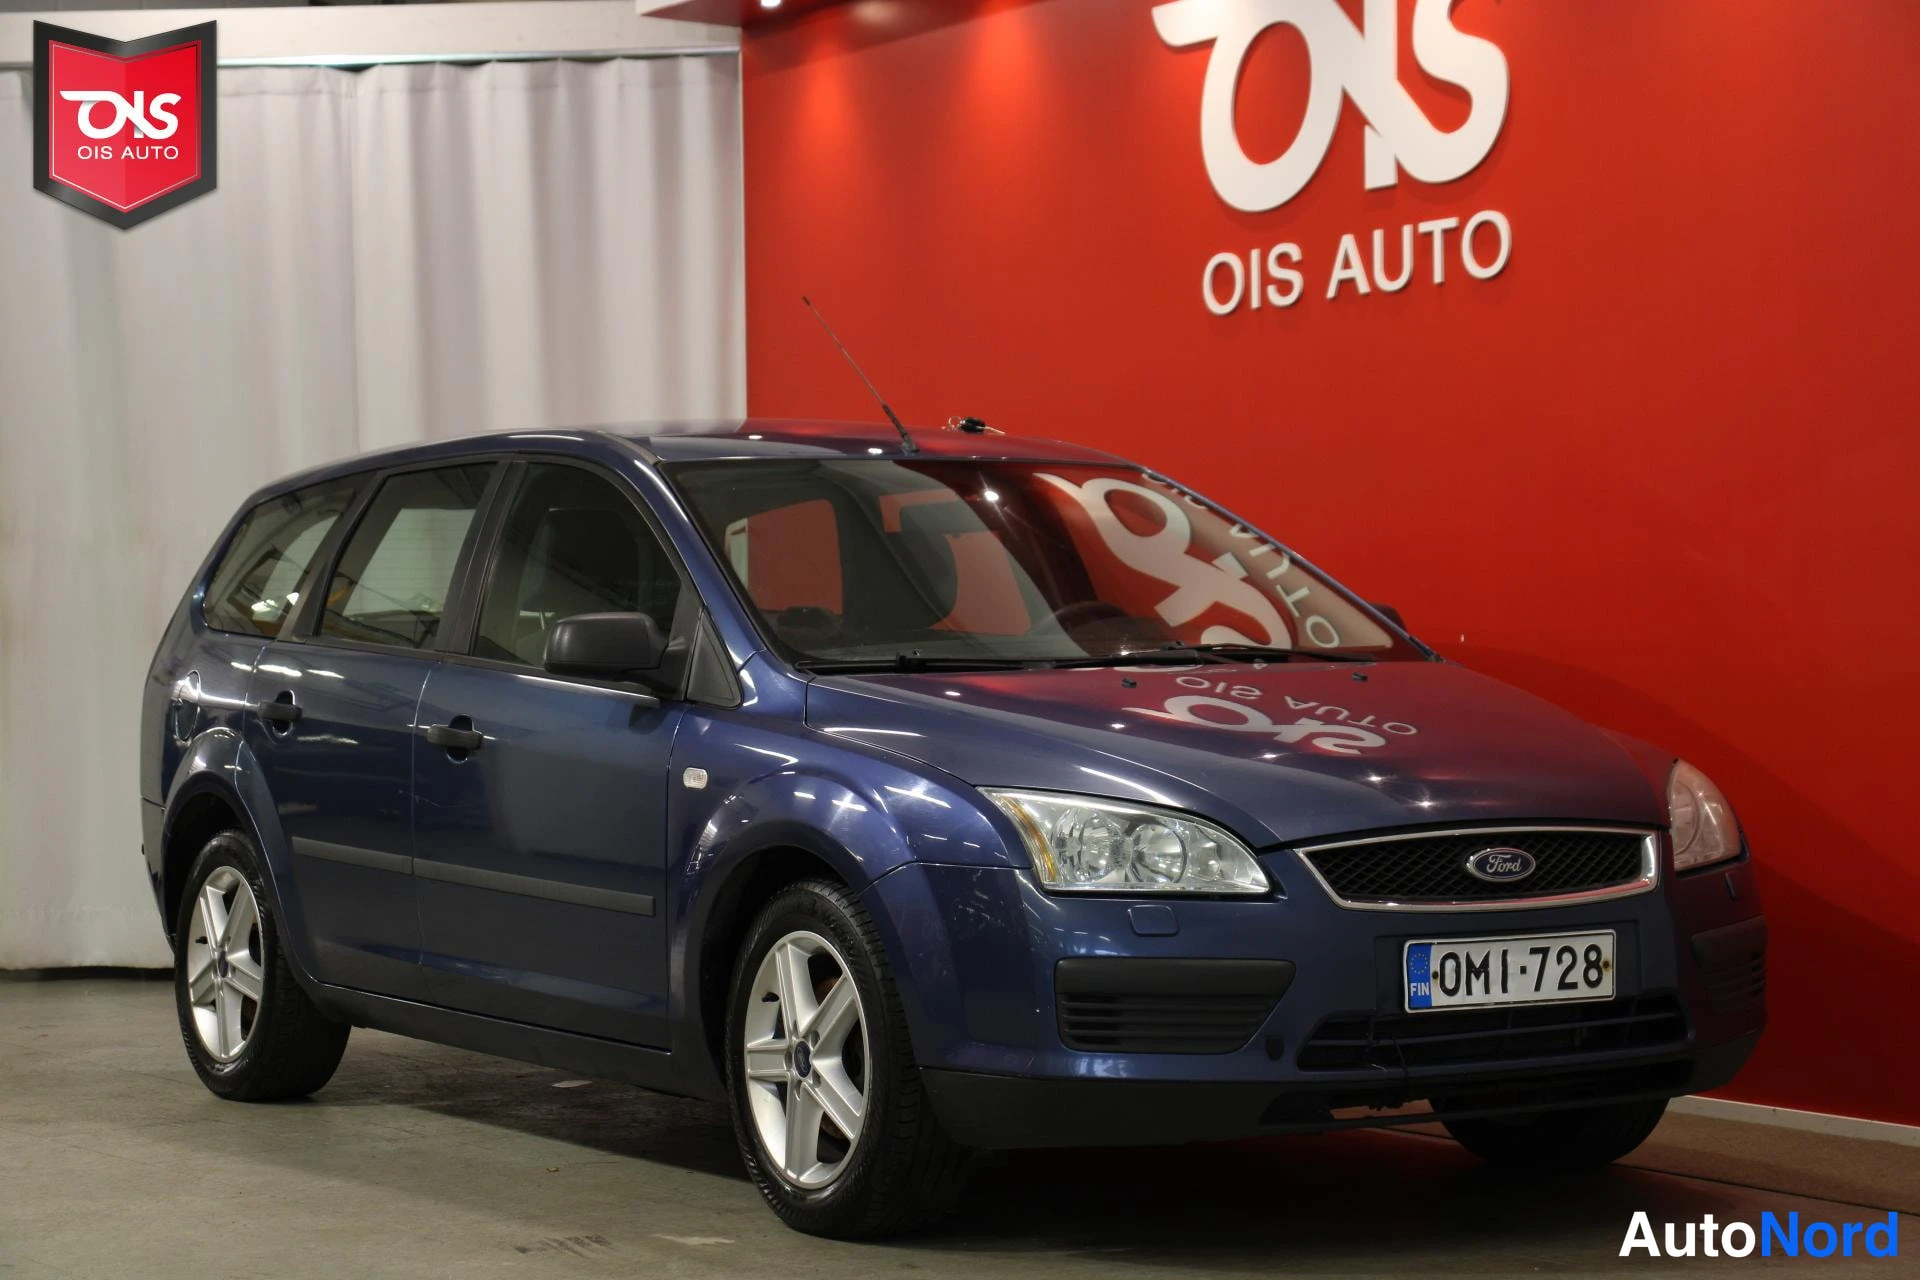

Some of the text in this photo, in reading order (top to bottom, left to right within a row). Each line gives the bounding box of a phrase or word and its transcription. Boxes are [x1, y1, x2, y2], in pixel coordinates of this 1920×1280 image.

[1202, 210, 1513, 315] OIS AUTO
[1486, 854, 1522, 873] Ford
[1438, 943, 1604, 998] OMI-728
[1410, 982, 1430, 997] FIN
